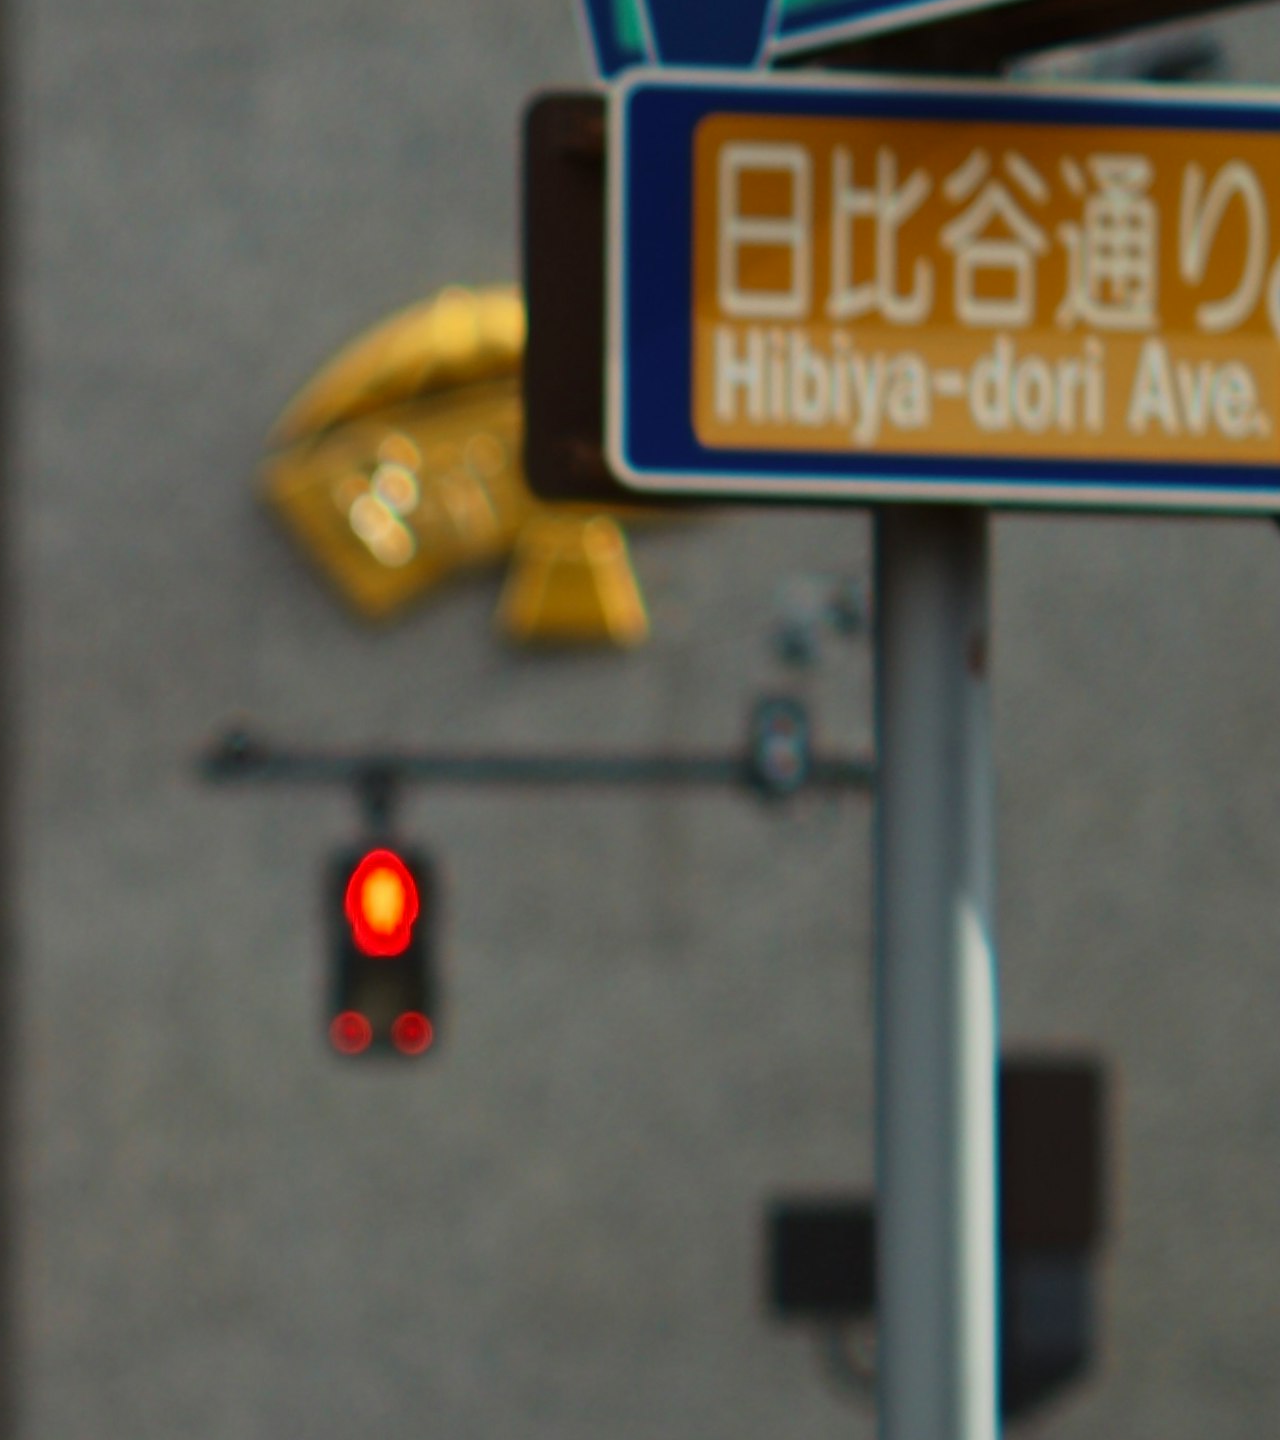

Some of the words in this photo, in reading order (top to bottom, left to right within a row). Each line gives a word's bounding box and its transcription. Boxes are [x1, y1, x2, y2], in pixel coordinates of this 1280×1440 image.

[717, 141, 1270, 332] 日比谷通り
[712, 328, 1106, 450] Hibiya-dori
[1126, 336, 1274, 440] Ave.
